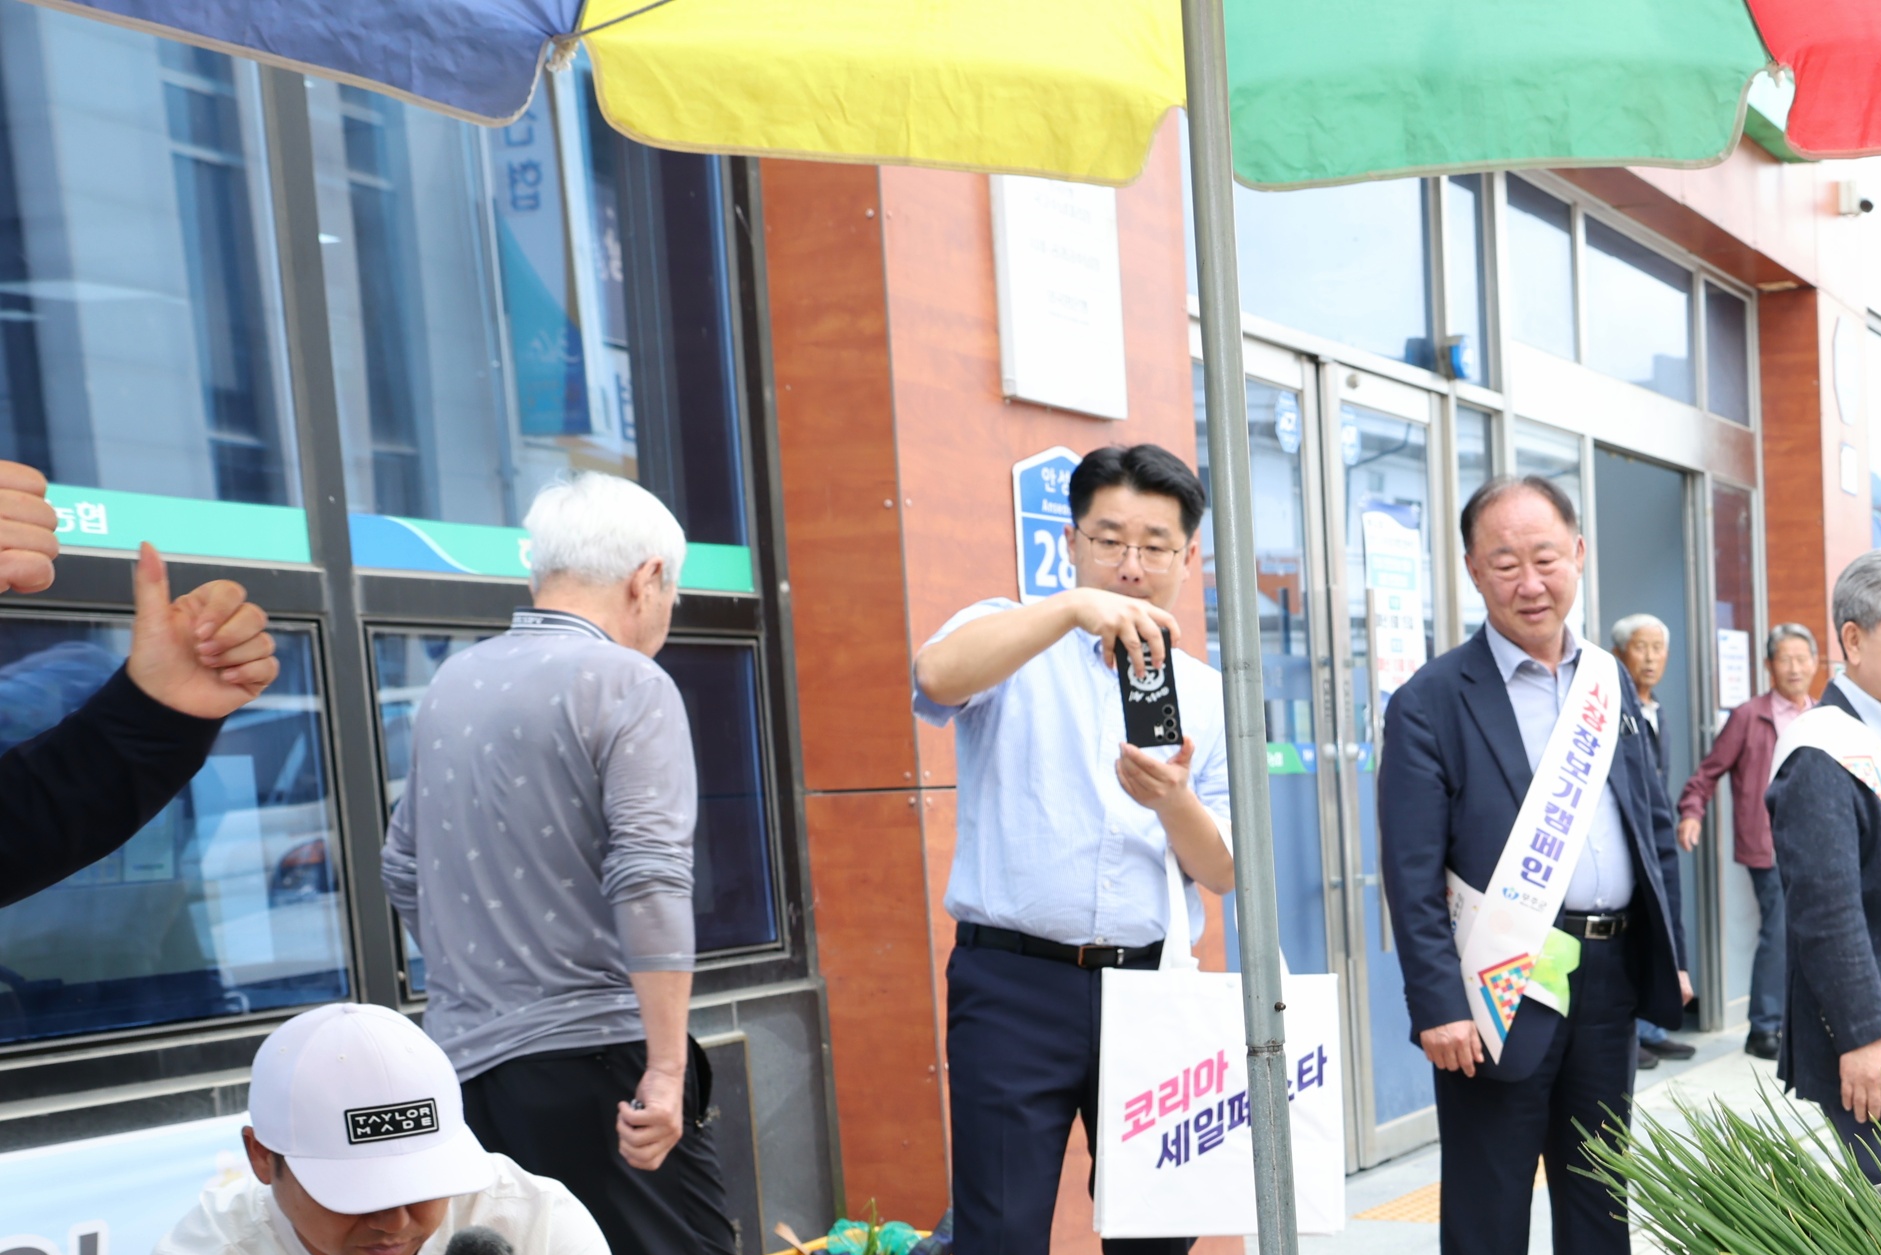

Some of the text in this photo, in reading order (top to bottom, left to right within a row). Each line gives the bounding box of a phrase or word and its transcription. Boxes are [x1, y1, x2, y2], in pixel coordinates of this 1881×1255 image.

[354, 1106, 432, 1126] TAYLOR
[1121, 1048, 1230, 1143] 코리아
[1155, 1043, 1328, 1170] 세일페타
[356, 1116, 433, 1137] MADE
